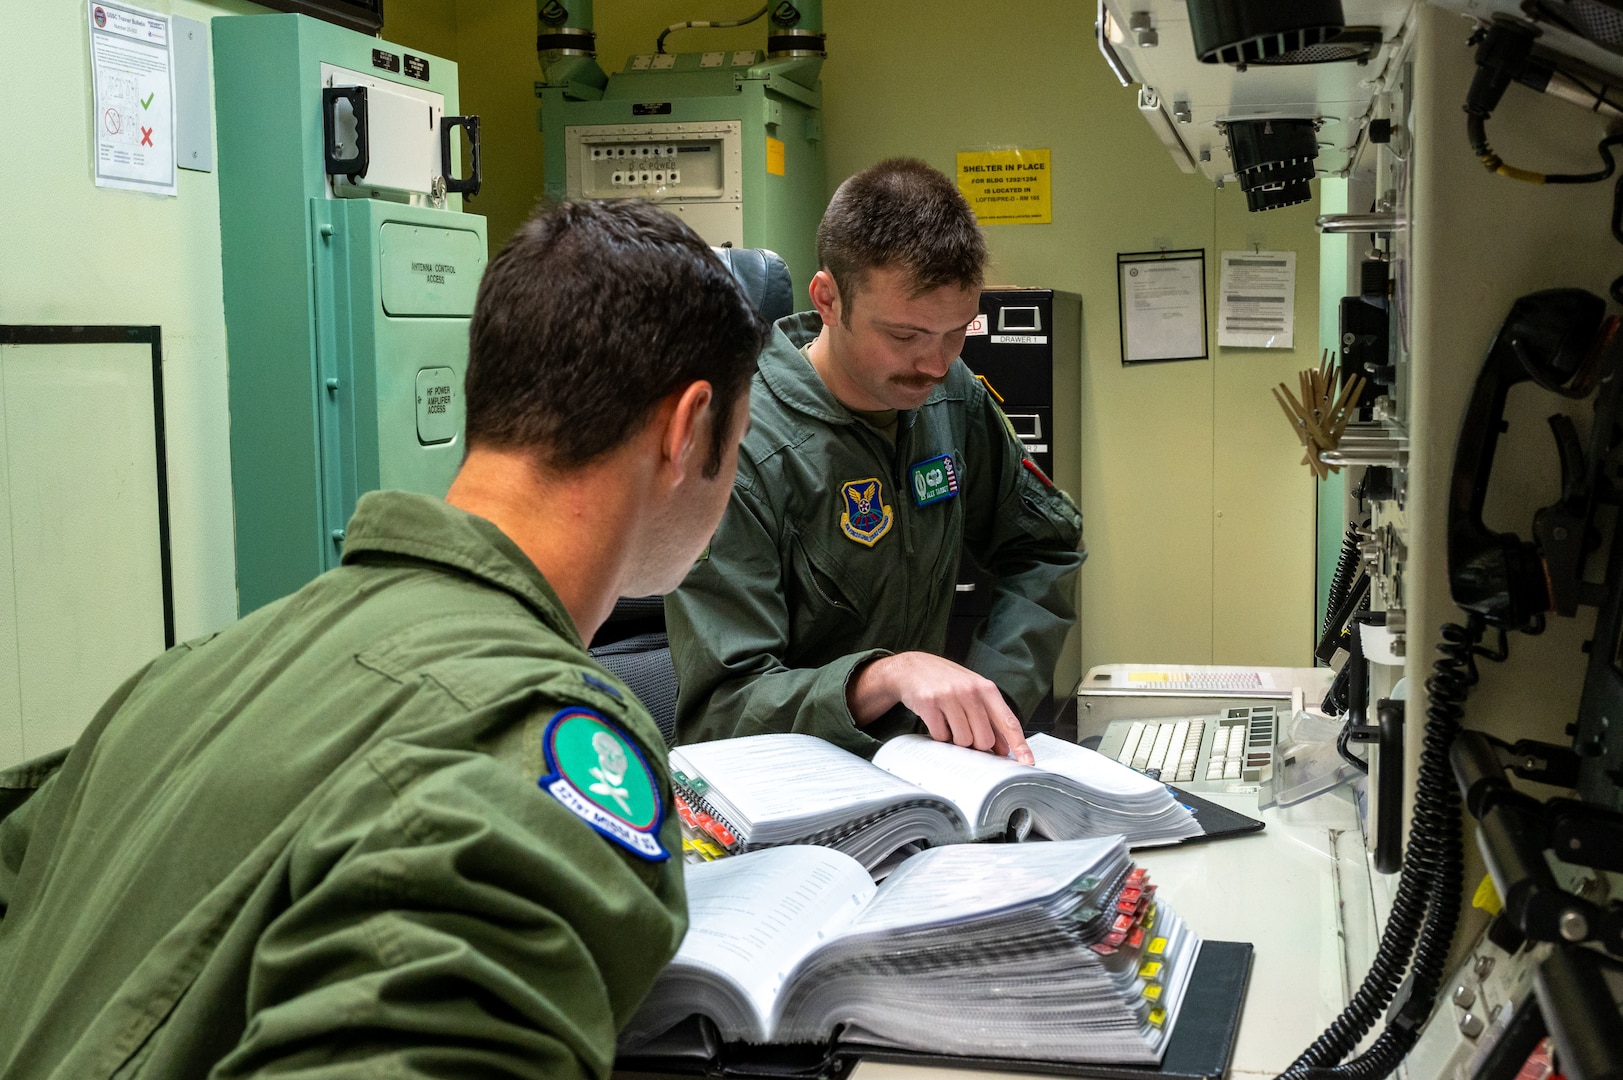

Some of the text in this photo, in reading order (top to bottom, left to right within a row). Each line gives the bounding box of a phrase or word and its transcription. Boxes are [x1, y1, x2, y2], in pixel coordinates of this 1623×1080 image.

[649, 161, 676, 169] POWER
[963, 164, 1003, 173] SHELTER
[1017, 163, 1045, 171] PLACE
[411, 261, 456, 274] ANTENNA CONTROL
[426, 275, 445, 284] ACCESS
[1000, 335, 1031, 343] DRAWER
[427, 386, 451, 396] HF POWER
[427, 395, 451, 405] AMPLIFIER
[427, 404, 446, 414] ACCESS
